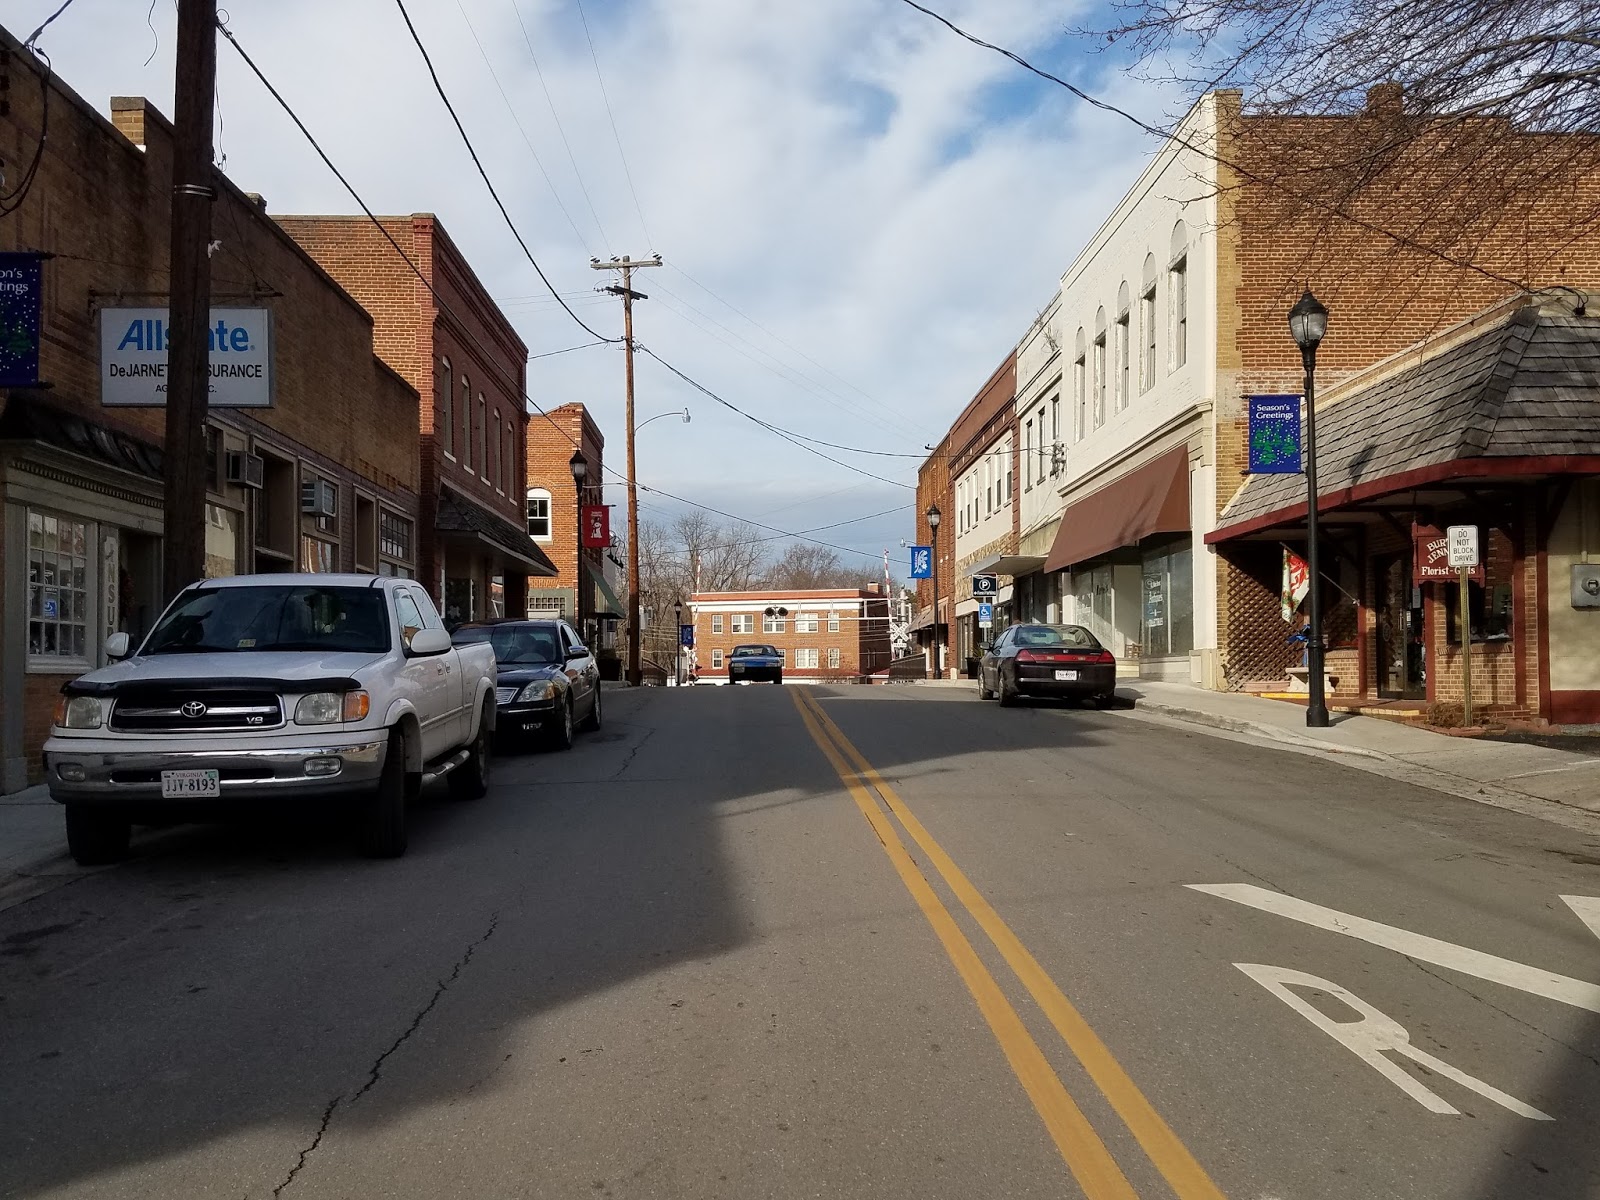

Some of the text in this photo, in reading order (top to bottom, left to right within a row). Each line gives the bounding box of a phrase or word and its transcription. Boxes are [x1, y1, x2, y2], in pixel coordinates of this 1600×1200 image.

[117, 319, 249, 352] Allte
[109, 363, 169, 377] DeJARNE
[1255, 411, 1294, 420] Greetings
[1453, 547, 1474, 555] BLOCK
[1421, 566, 1449, 576] Florist
[165, 778, 216, 792] JJV-8193
